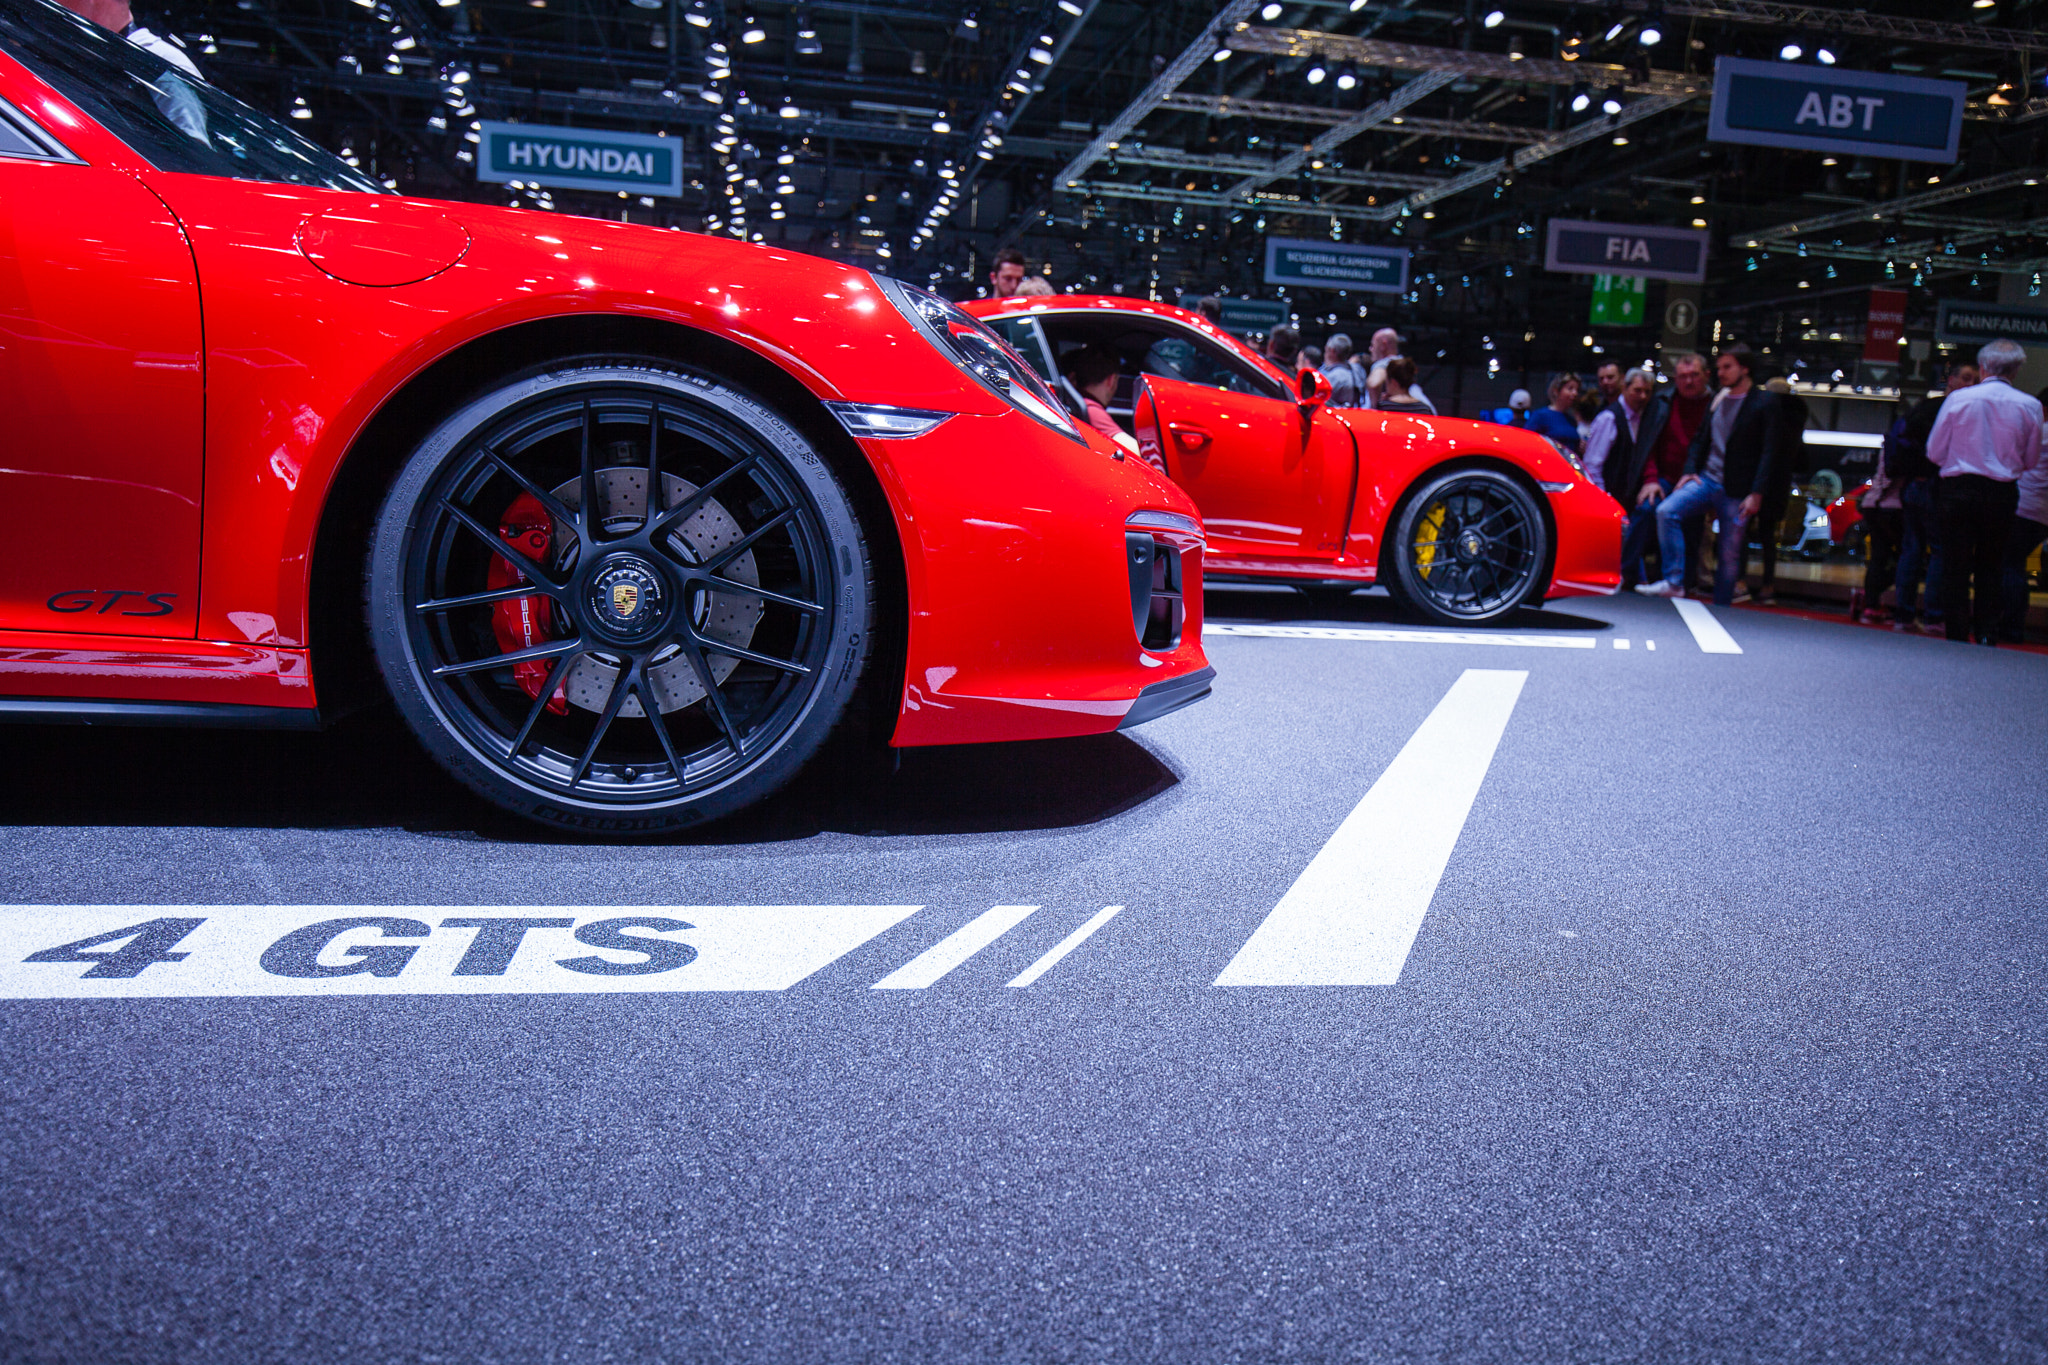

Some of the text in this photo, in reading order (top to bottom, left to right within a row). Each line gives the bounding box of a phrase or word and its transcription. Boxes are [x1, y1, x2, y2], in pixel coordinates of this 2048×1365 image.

[1795, 91, 1885, 132] ABT
[508, 141, 654, 176] HYUNDAI
[1606, 237, 1651, 262] FIA
[1950, 314, 2048, 335] PININFARINA
[725, 389, 757, 408] PILOT
[758, 408, 793, 437] SPORT
[46, 589, 178, 616] GTS
[21, 916, 699, 979] 4 GTS
